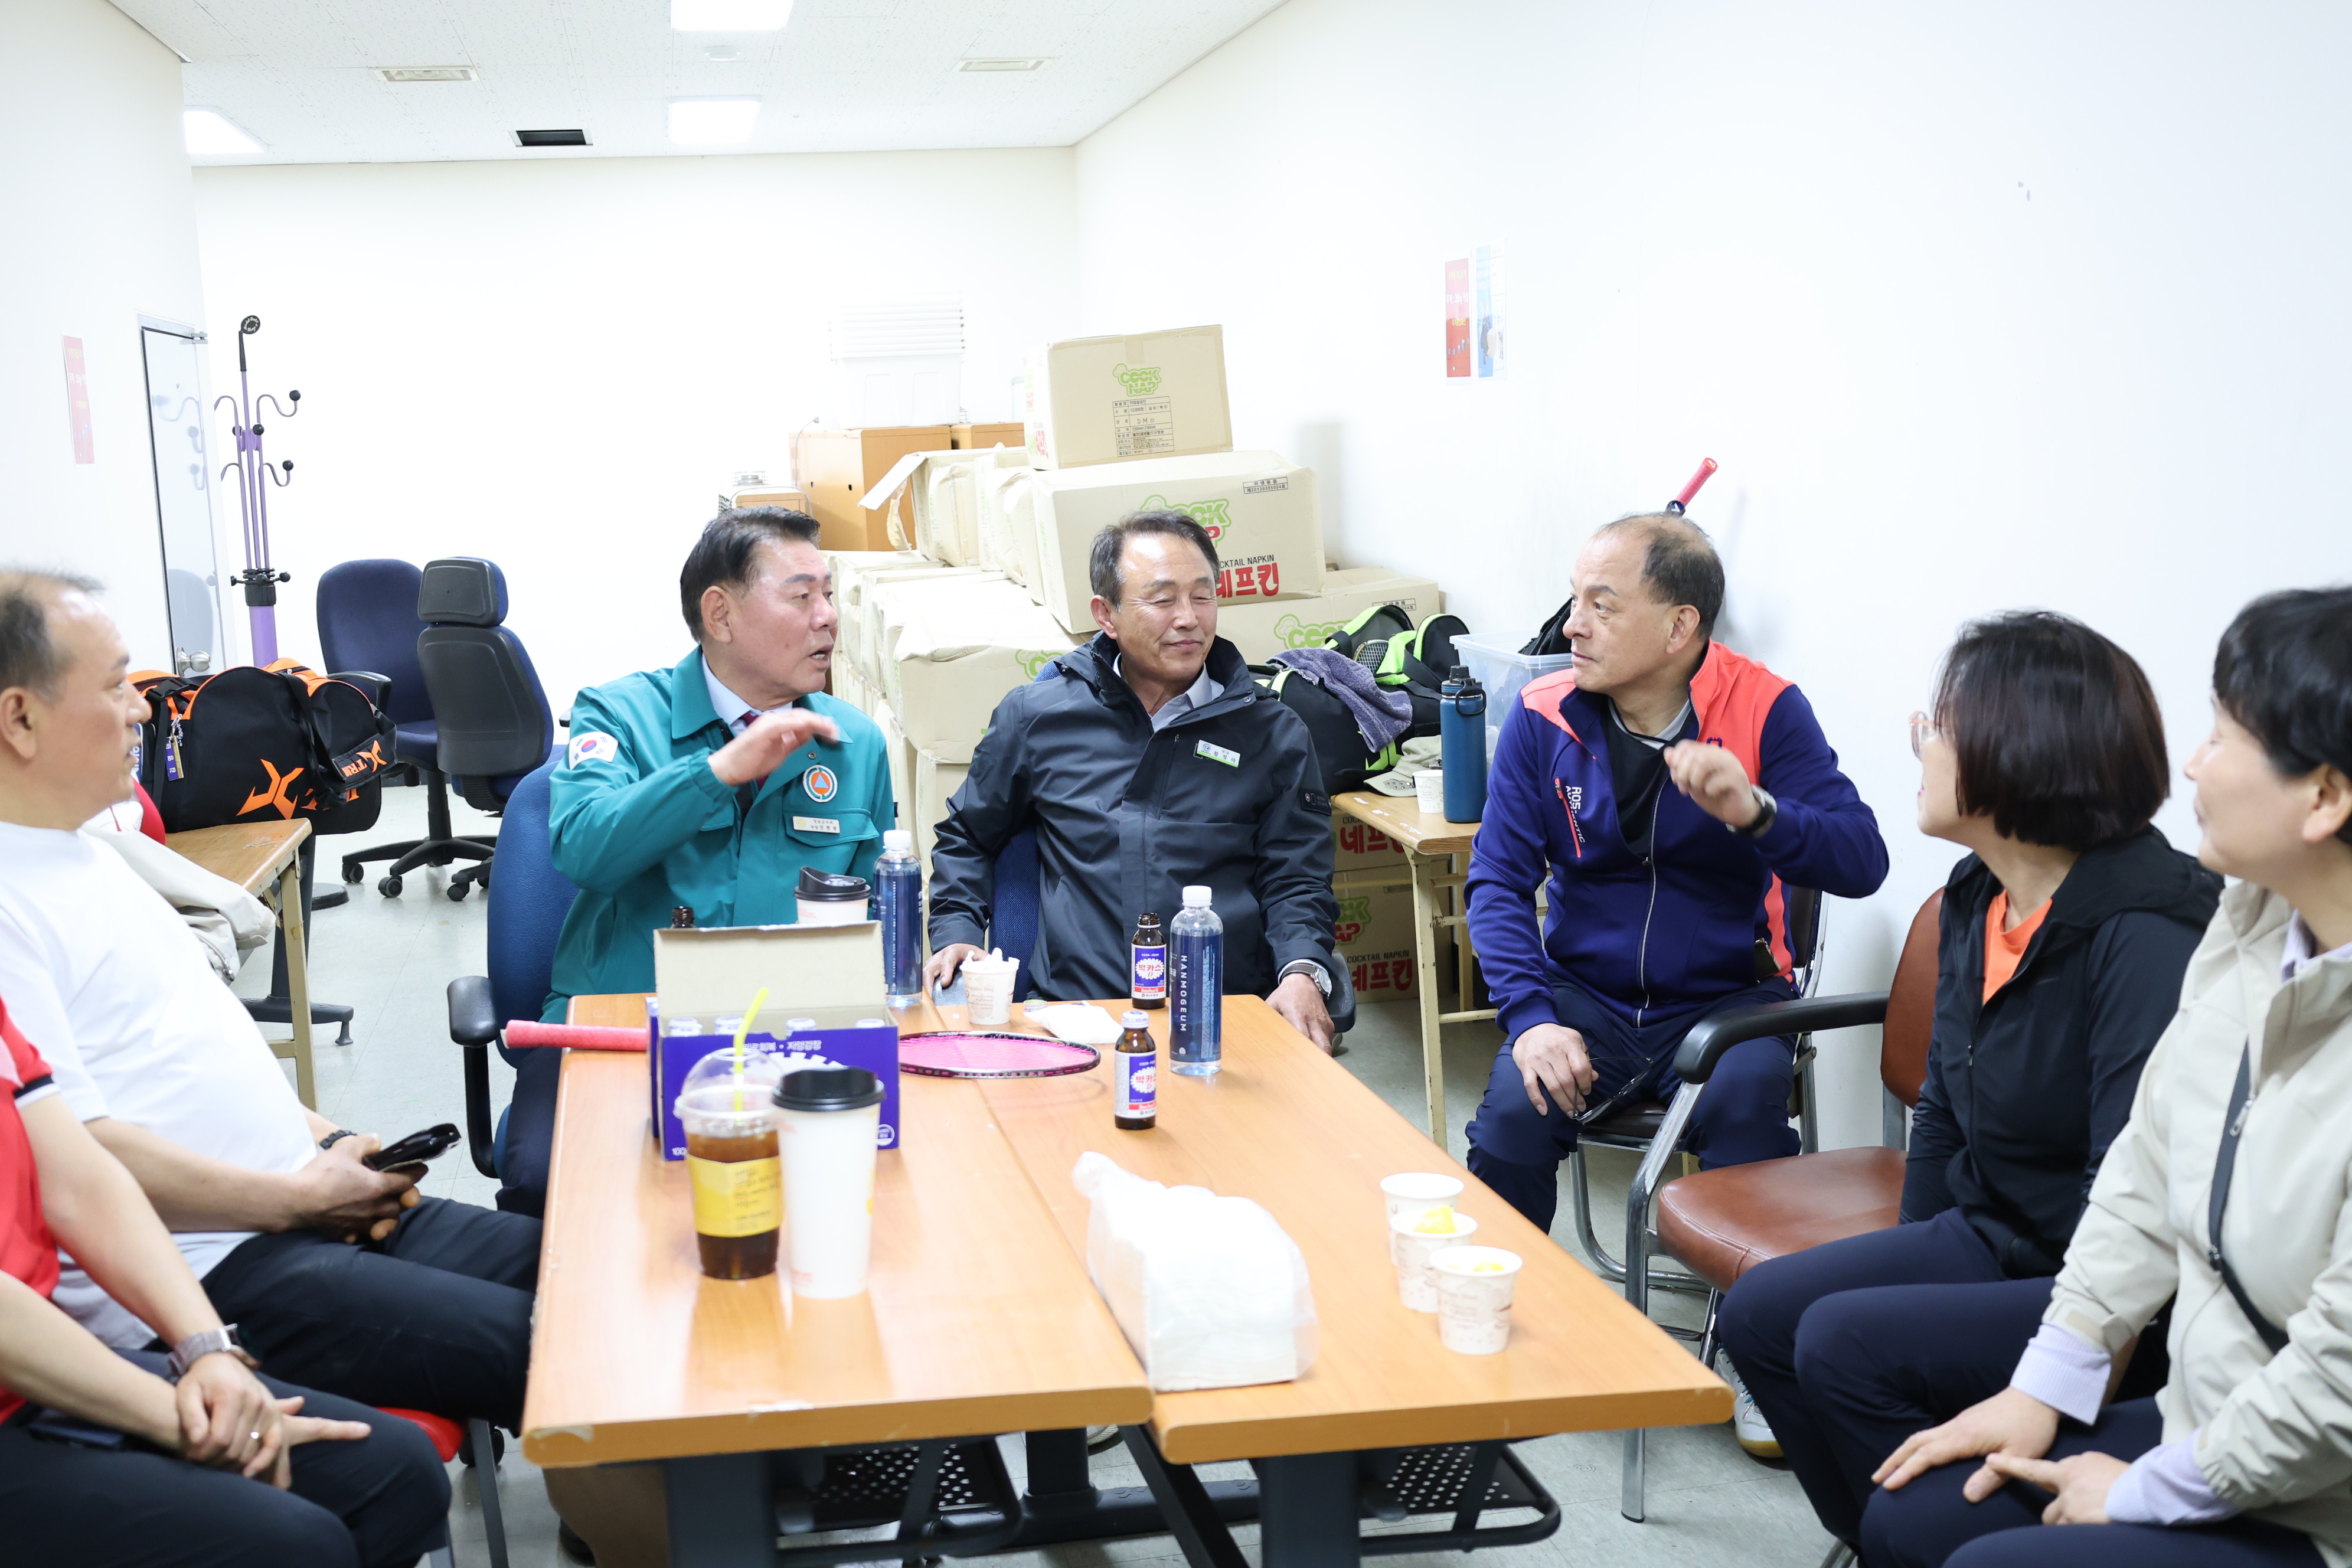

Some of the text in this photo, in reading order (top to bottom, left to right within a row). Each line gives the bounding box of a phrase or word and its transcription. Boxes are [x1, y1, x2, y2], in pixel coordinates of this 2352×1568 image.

[1120, 370, 1159, 384] COOK
[1128, 381, 1157, 394] NAP
[1247, 554, 1275, 565] NAPKIN
[1340, 824, 1404, 854] 네프
[1334, 923, 1360, 942] AP
[1347, 949, 1410, 963] COCKTAIL NAPKIN
[1138, 963, 1161, 972] 박카스
